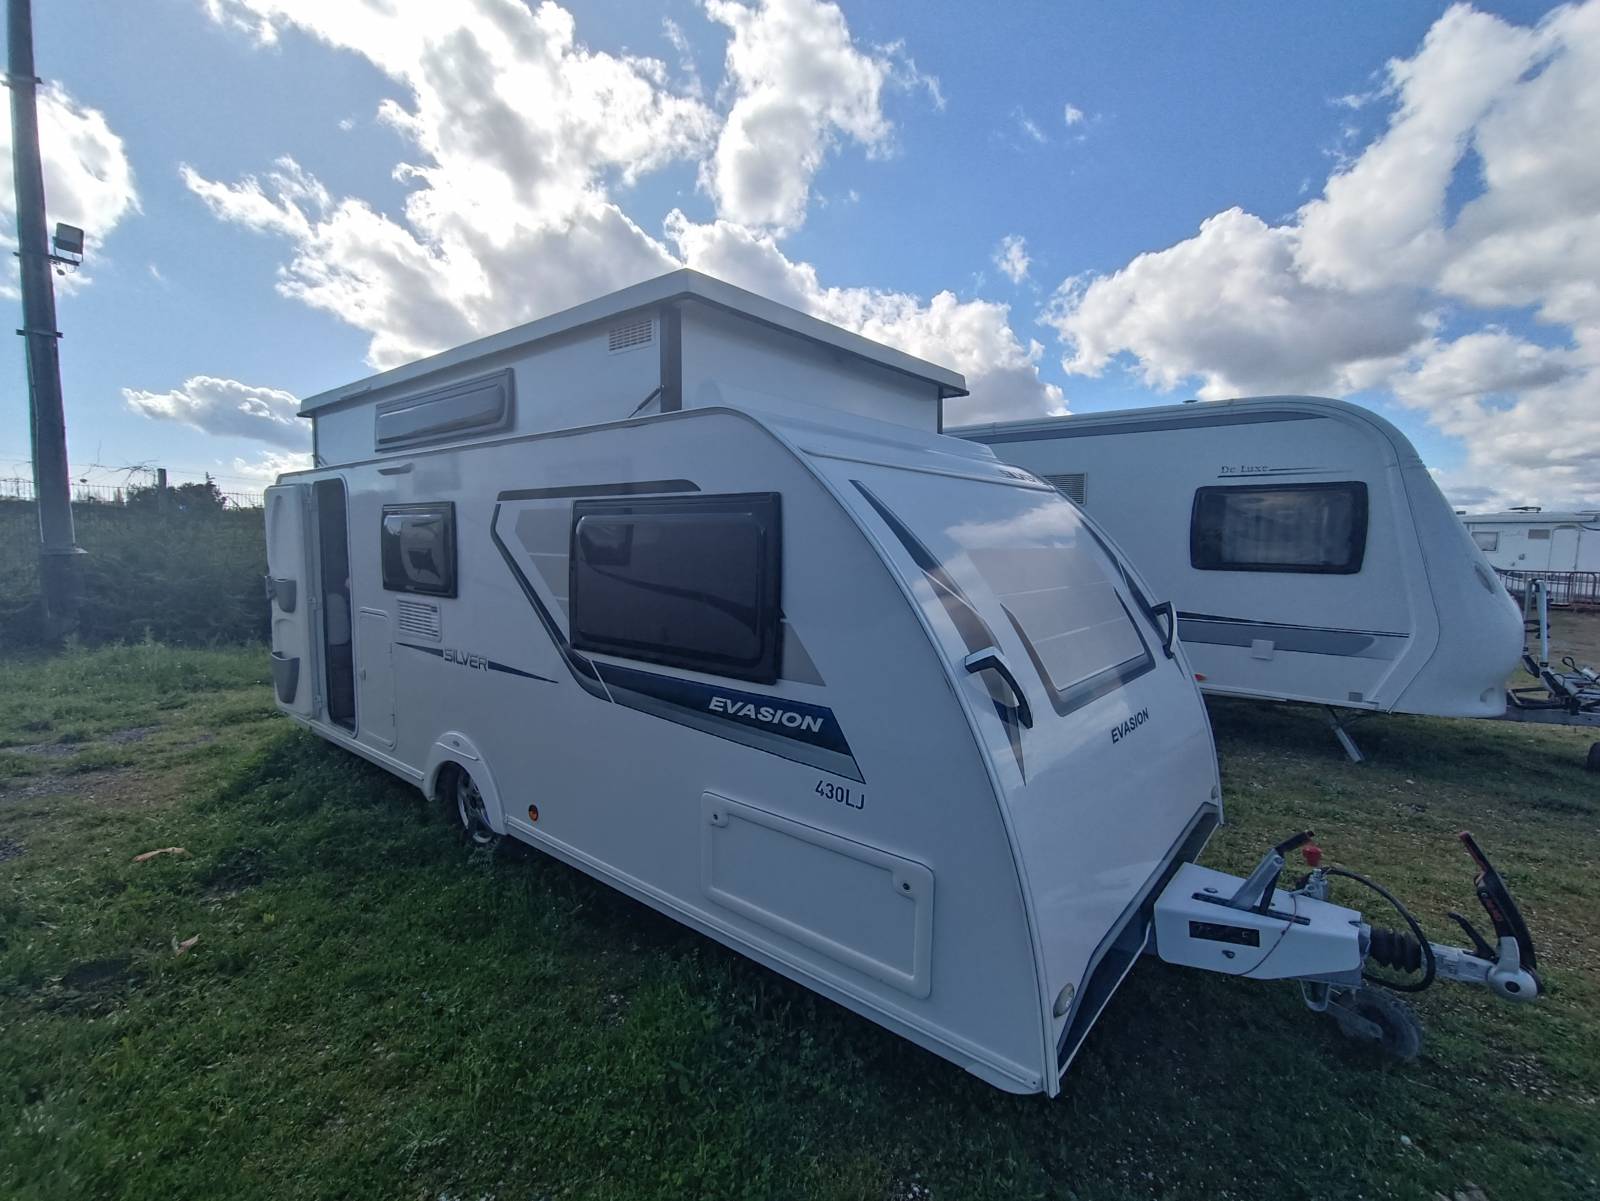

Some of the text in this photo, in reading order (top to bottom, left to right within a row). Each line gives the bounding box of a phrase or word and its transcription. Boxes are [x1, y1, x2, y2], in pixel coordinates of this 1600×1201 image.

[444, 648, 488, 672] SILVER
[708, 696, 825, 733] EVASION
[1111, 707, 1150, 745] EVASION
[815, 780, 866, 811] 430LJ
